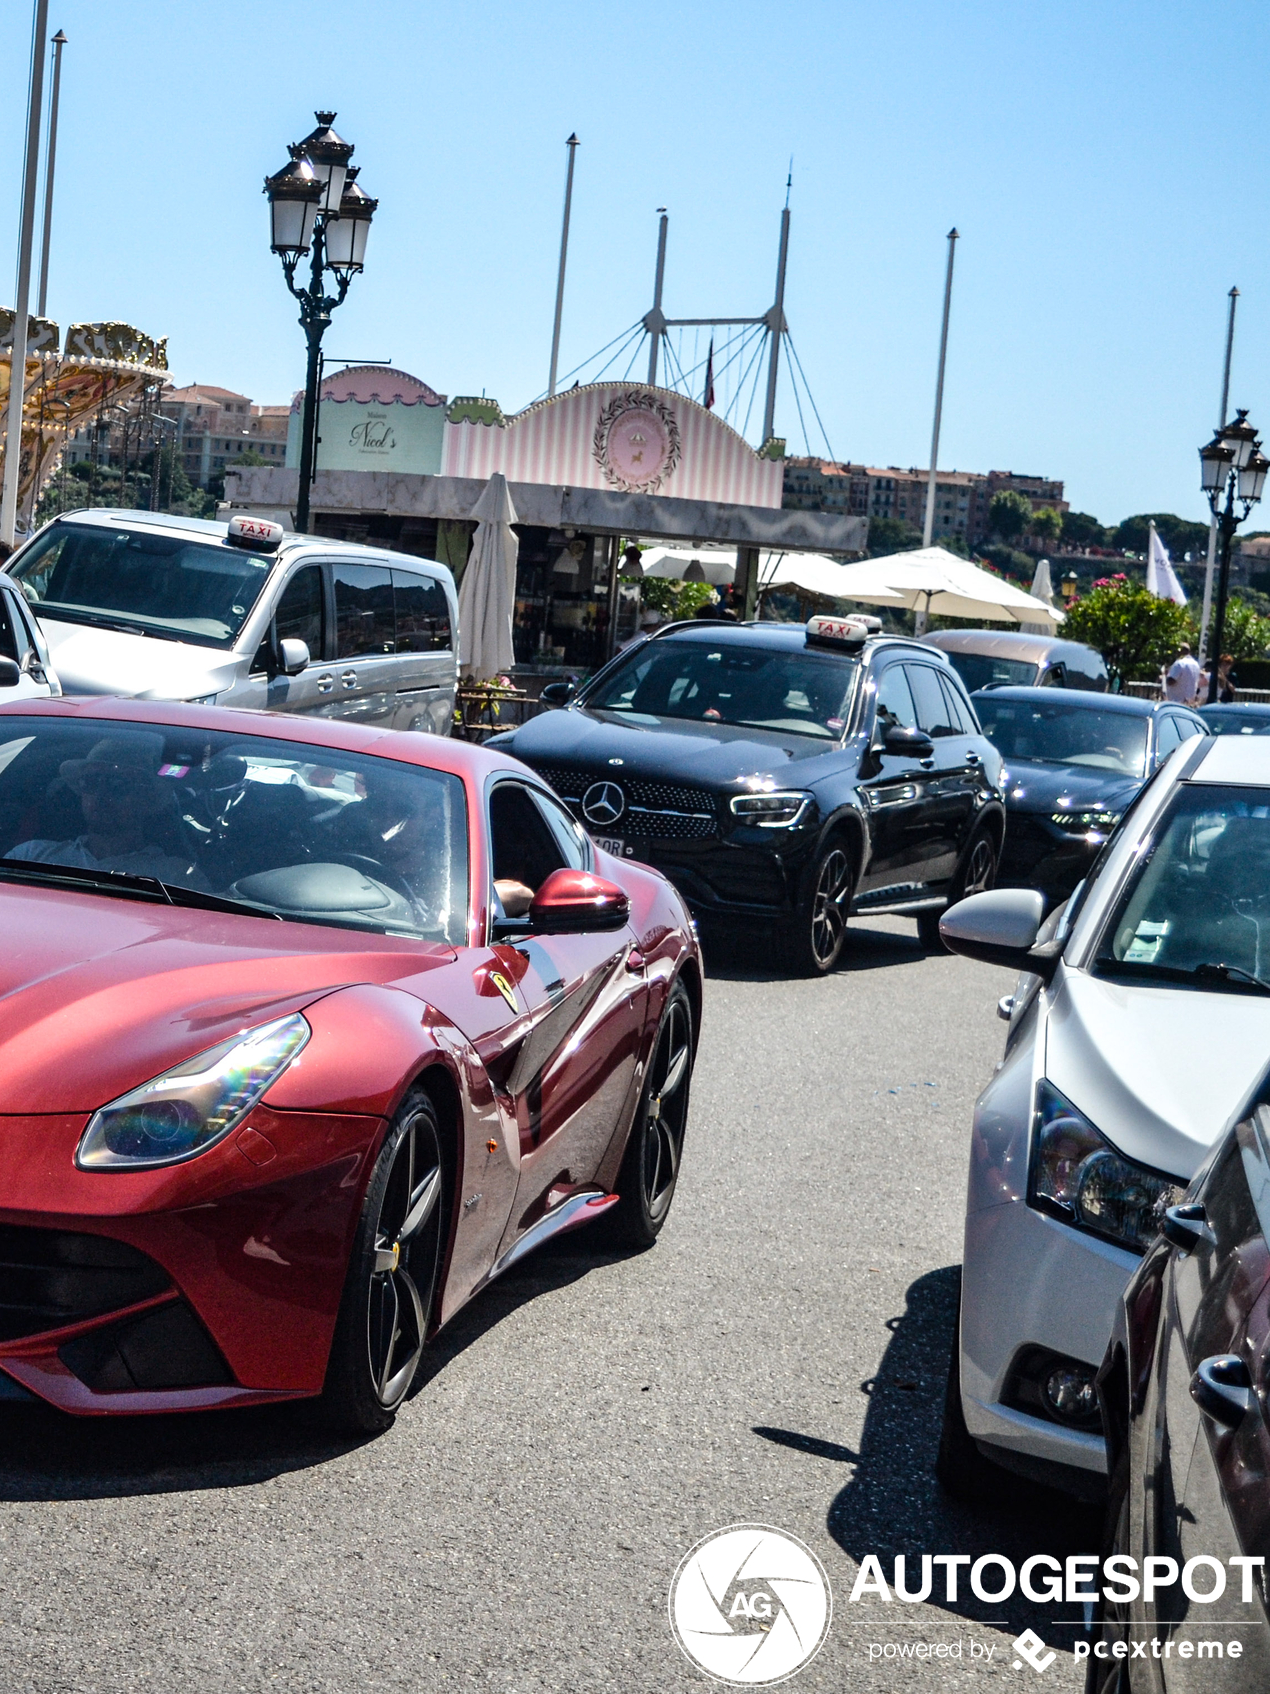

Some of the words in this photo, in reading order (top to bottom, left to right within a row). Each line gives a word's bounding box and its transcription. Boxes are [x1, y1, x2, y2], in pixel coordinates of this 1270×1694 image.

[349, 420, 397, 448] Nicol's
[240, 523, 271, 538] TAXI
[817, 621, 851, 636] TAXI
